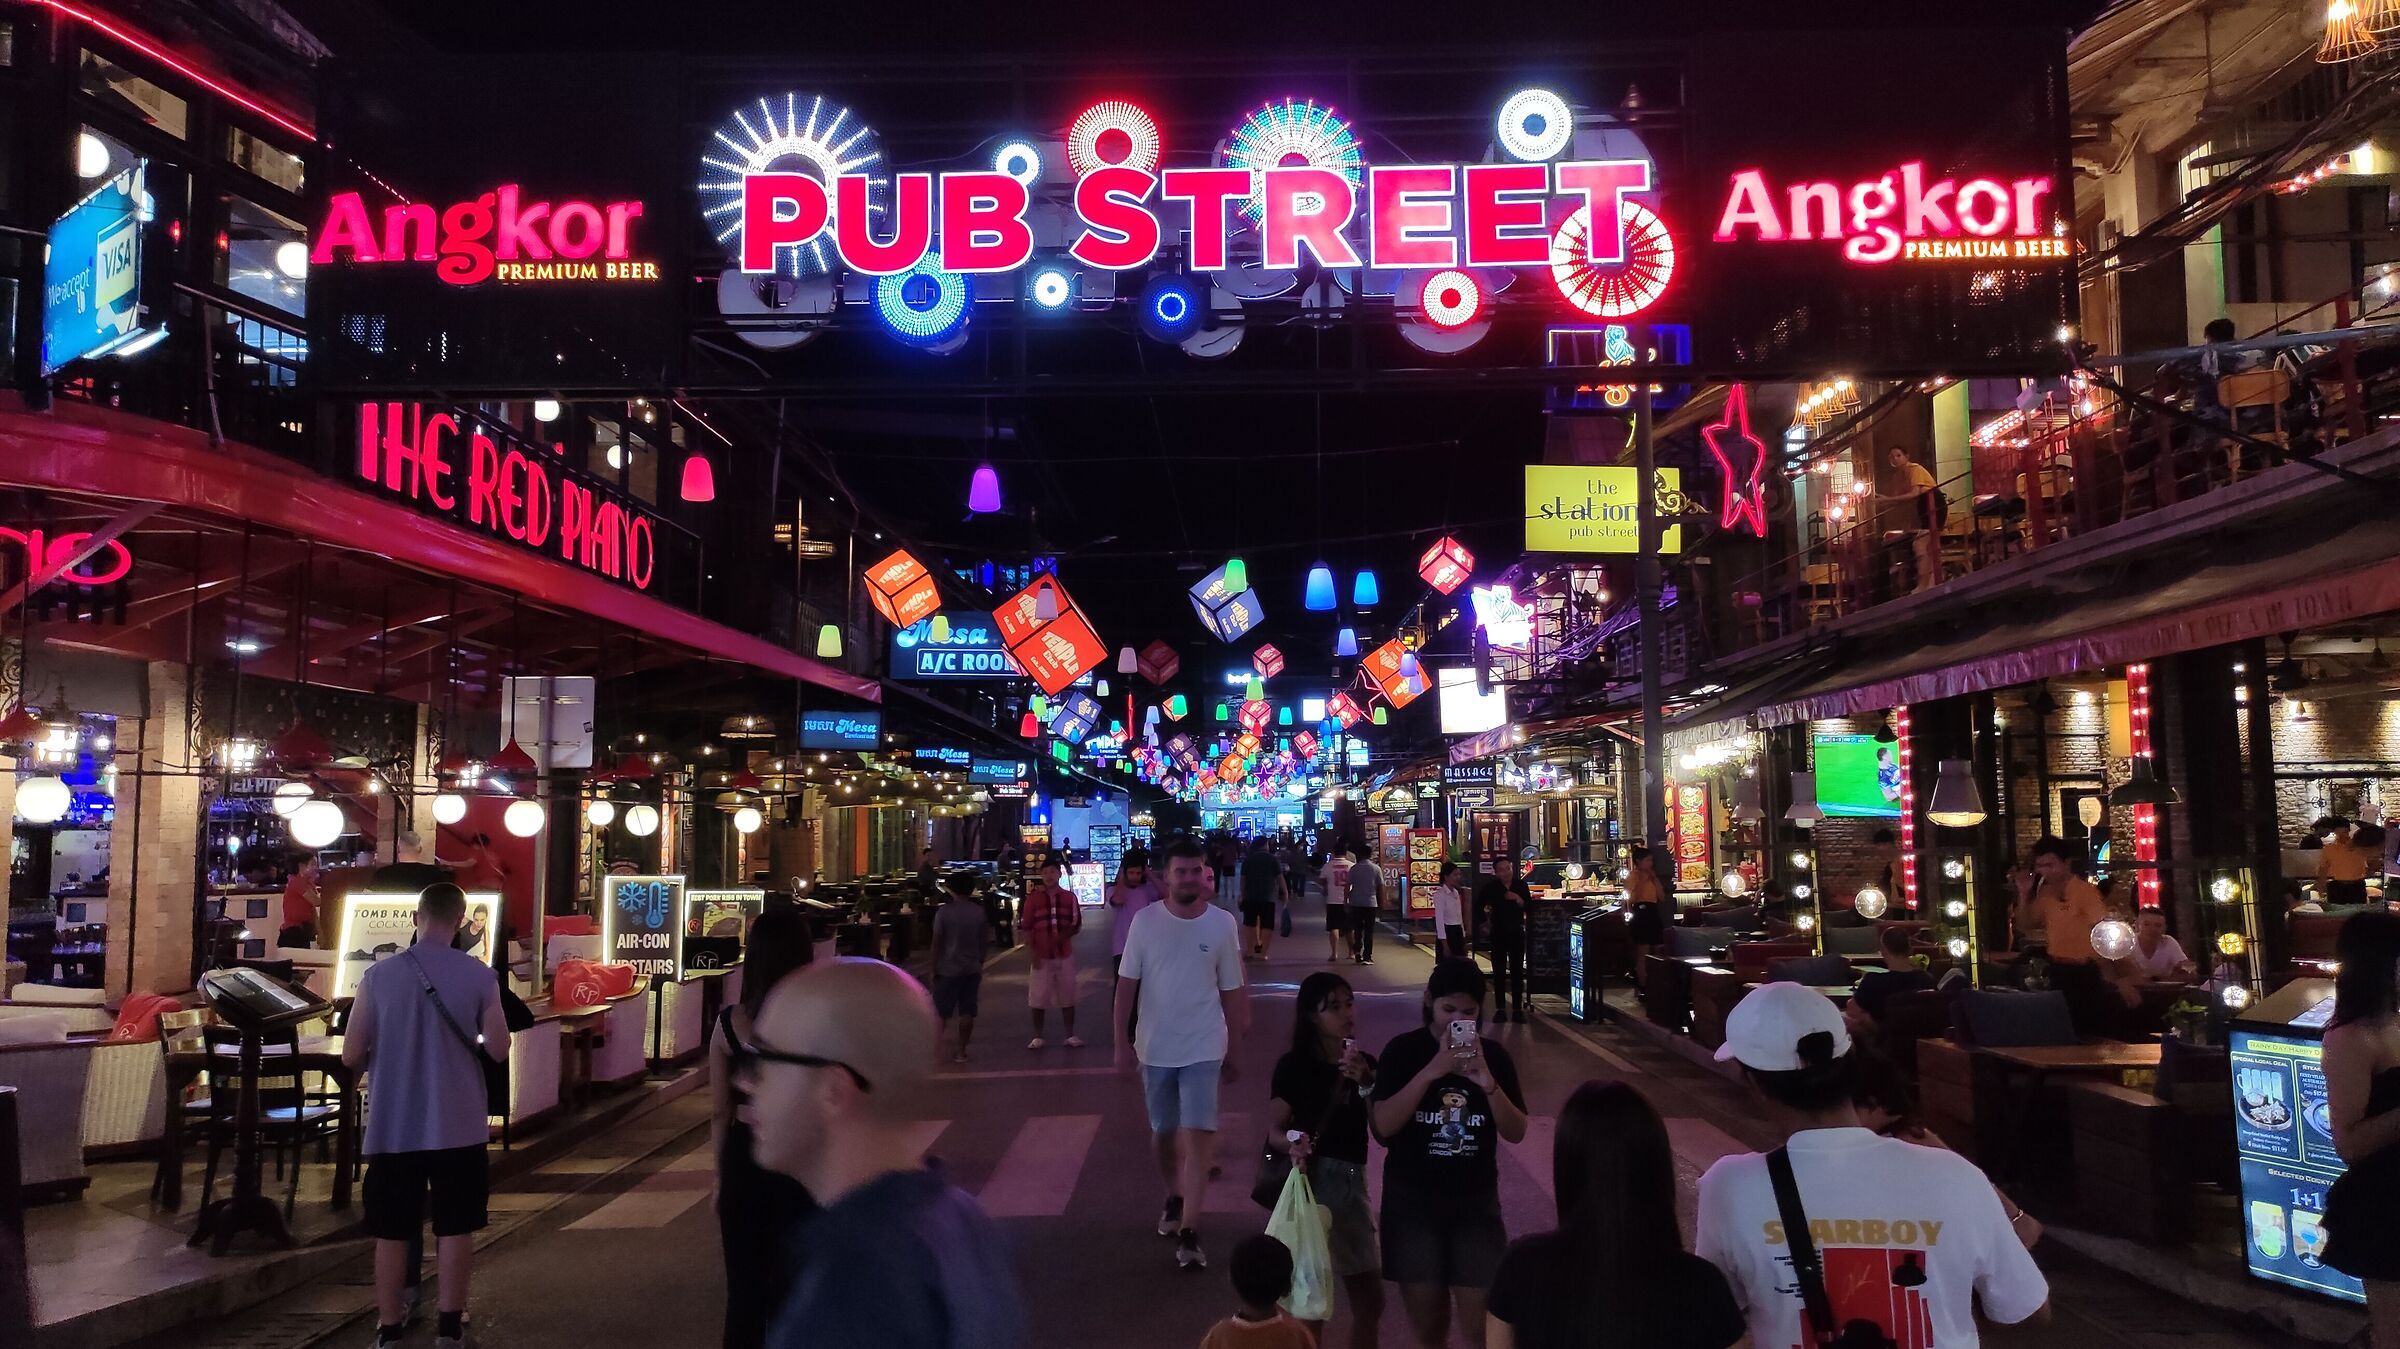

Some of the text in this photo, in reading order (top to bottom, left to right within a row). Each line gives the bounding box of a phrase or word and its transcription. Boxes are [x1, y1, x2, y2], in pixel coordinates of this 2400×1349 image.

[740, 160, 1651, 276] PUB STREET
[1712, 160, 2053, 263] Angkor
[310, 184, 643, 285] Angkor
[1905, 239, 2069, 259] PREMIUM BEER
[103, 238, 131, 280] VISA
[497, 262, 659, 280] PREMIUM BEER
[360, 401, 654, 590] THE RED PIANO
[1587, 479, 1618, 496] the
[1540, 496, 1639, 521] station
[1569, 525, 1639, 540] pub street
[1230, 601, 1249, 632] TEMPLE
[1041, 631, 1080, 676] TEMPLE
[920, 652, 956, 674] A/C
[835, 719, 877, 733] Mesa
[1085, 735, 1123, 750] TMPLE
[938, 747, 970, 759] Mesa
[989, 765, 1015, 774] Mesa
[1444, 767, 1493, 777] MASSAGE
[354, 909, 415, 918] TOMB RAI
[368, 920, 414, 929] COCKTA
[616, 933, 670, 949] AIR-CON
[575, 985, 598, 1004] RP
[2250, 1041, 2270, 1050] RAINY
[2288, 1047, 2312, 1055] HAPPY
[2268, 1168, 2335, 1186] SELECTED COCKTA
[2290, 1187, 2323, 1211] 1+1
[1763, 1219, 1944, 1246] SARBOY
